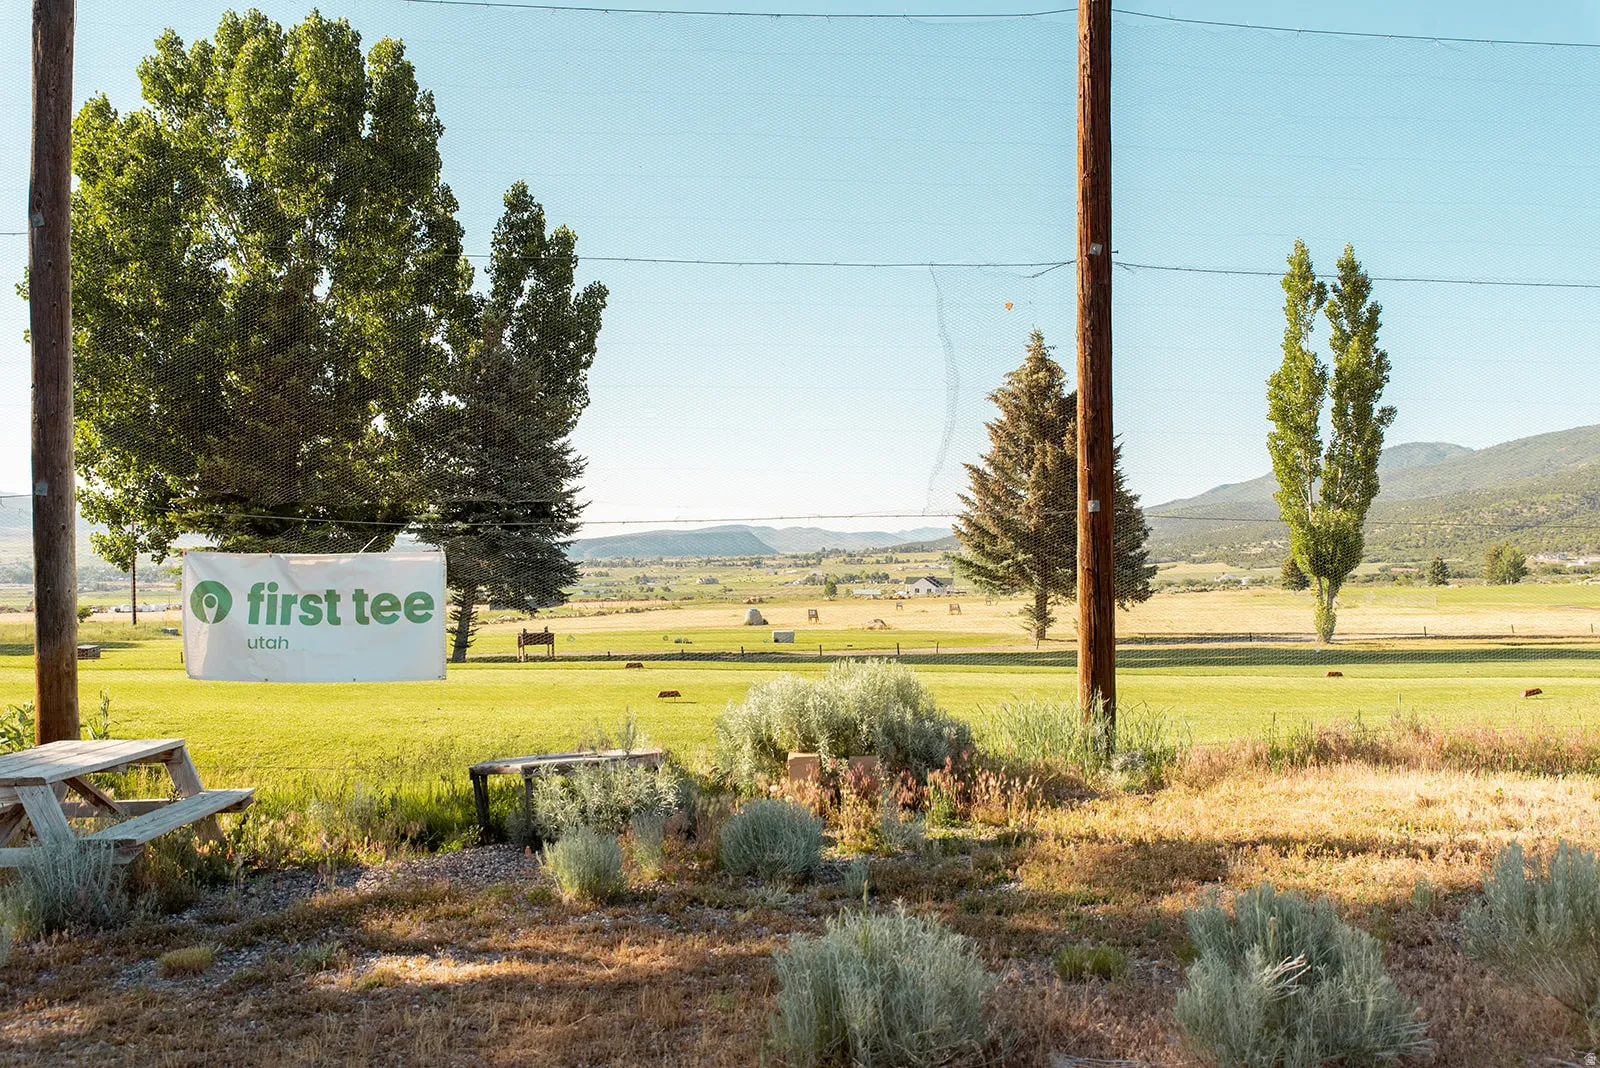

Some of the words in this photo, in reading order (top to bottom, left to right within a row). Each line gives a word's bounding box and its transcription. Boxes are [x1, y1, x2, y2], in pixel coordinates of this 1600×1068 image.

[247, 581, 341, 626] first
[352, 588, 435, 625] tee
[247, 635, 289, 650] utah
